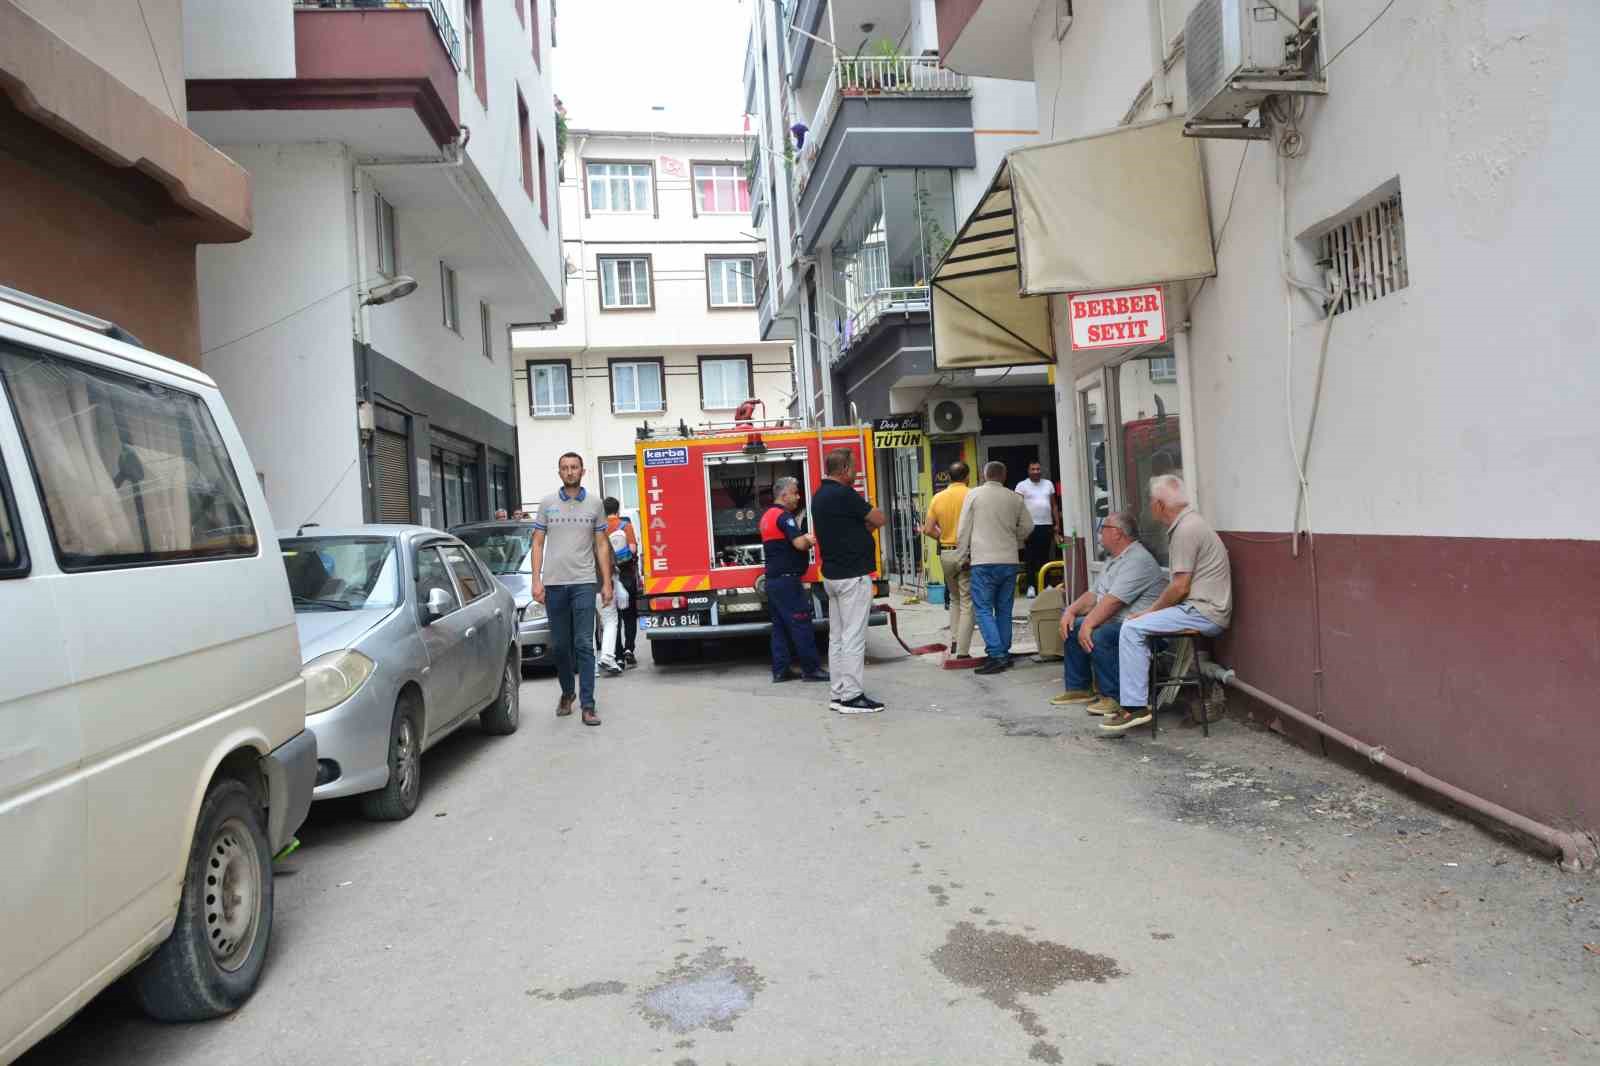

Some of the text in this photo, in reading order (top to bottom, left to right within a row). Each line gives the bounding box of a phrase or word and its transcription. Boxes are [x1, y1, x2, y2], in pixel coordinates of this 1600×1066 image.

[1073, 294, 1159, 319] BERBER
[1088, 316, 1148, 342] SEYİT
[876, 432, 921, 447] TÜTÜN
[646, 450, 685, 458] karba
[648, 475, 669, 571] İTFAİYE
[646, 614, 698, 627] 52 AG 814
